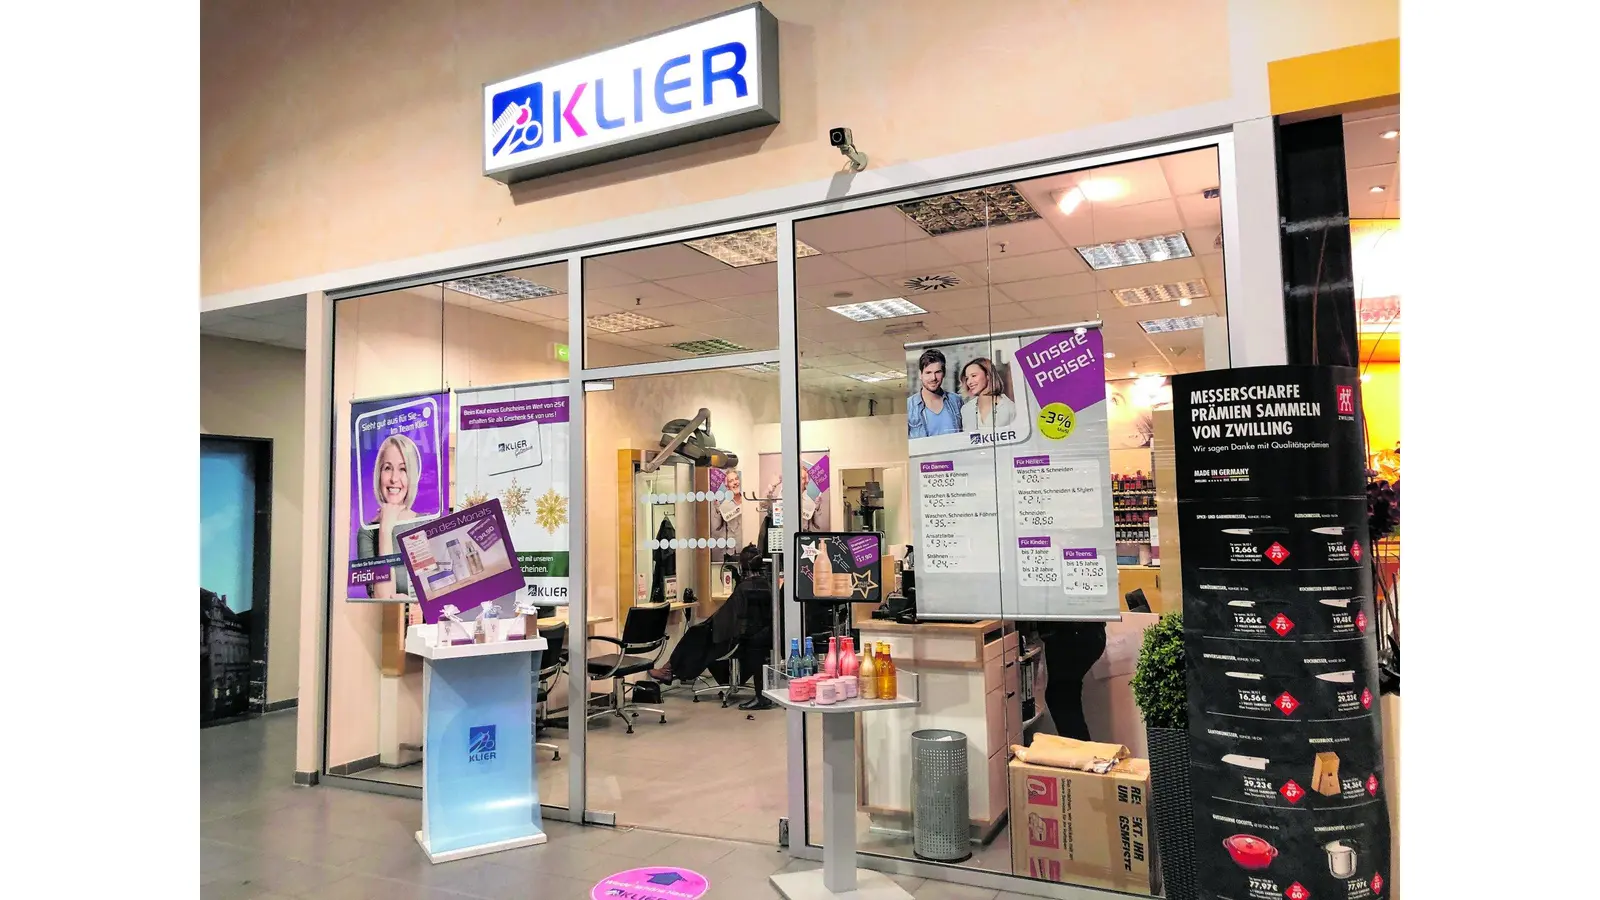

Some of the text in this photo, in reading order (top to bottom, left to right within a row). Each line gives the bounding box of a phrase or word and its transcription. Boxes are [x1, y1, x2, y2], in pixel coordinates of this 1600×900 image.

[553, 41, 748, 144] KLIER
[1026, 333, 1088, 369] Unsere
[1035, 348, 1096, 388] Preise!
[1191, 384, 1300, 405] MESSERSCHARFE
[504, 414, 526, 422] Geschenk
[1191, 402, 1321, 422] PRÄMIEN SAMMELN
[377, 420, 387, 430] gut
[1040, 411, 1071, 428] -3%
[400, 423, 415, 433] Team
[1192, 421, 1293, 440] VON ZWILLING
[982, 430, 1016, 443] KLIER
[506, 439, 527, 451] KLIER
[1208, 445, 1229, 453] sagen
[1230, 442, 1255, 451] Danke
[1271, 441, 1330, 450] Qualitätsprämien
[1194, 469, 1210, 477] MADE
[1219, 467, 1249, 476] GERMANY
[440, 519, 457, 532] des
[457, 507, 492, 526] Monats
[520, 564, 549, 573] cheinen.
[352, 569, 375, 584] Frisör
[538, 587, 568, 597] KLIER
[469, 751, 497, 763] KLIER
[1133, 841, 1144, 862] IHR
